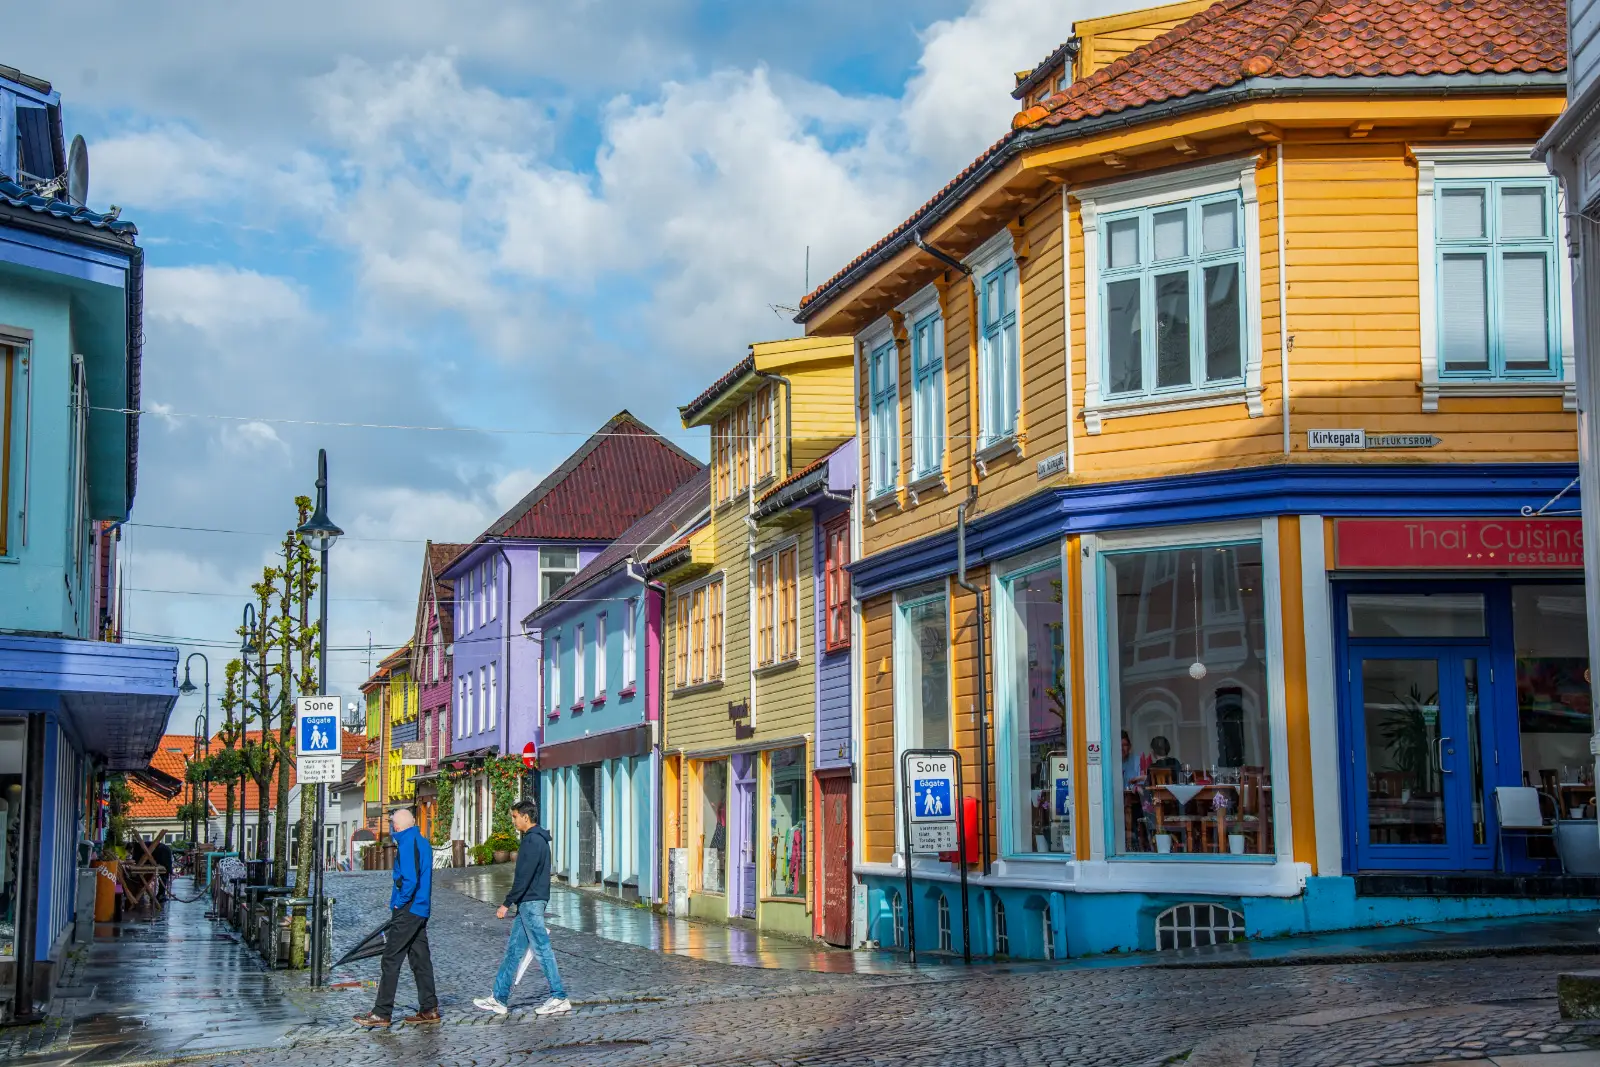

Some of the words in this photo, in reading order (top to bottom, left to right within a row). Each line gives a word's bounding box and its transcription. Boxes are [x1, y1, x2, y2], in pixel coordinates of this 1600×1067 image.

[1312, 431, 1360, 446] Kirkegata
[1368, 436, 1432, 446] TILFLUKTSROM
[1404, 523, 1467, 549] Thai
[1508, 551, 1584, 563] restaur
[304, 700, 334, 711] Sone
[306, 717, 331, 725] Gågate
[916, 761, 947, 773] Sone
[919, 780, 945, 788] Gågate
